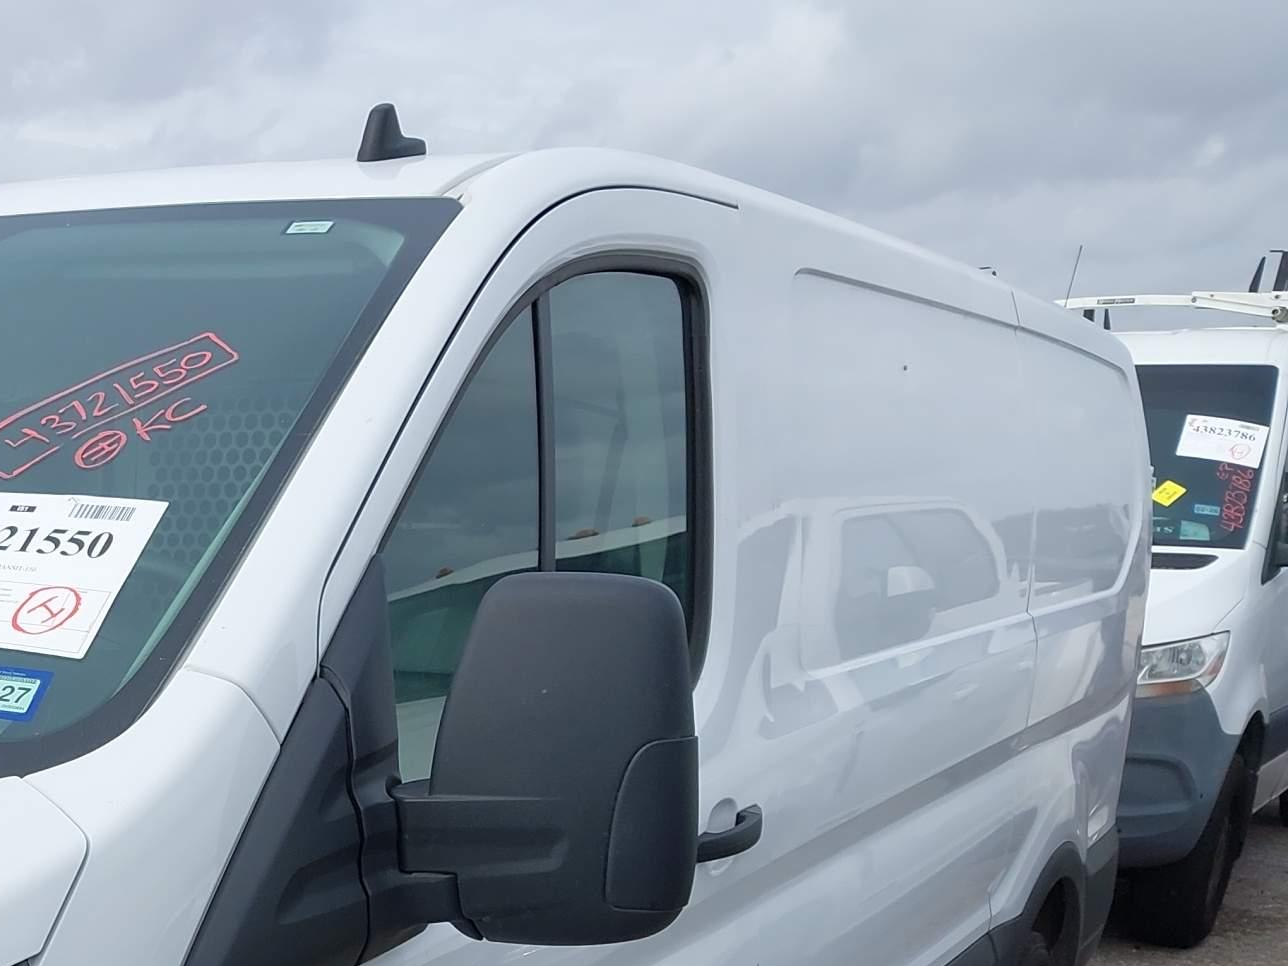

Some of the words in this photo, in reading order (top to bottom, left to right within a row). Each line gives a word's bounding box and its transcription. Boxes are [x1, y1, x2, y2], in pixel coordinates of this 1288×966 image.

[3, 350, 213, 449] 43721550
[132, 396, 208, 441] KC
[1192, 425, 1257, 442] 43823786
